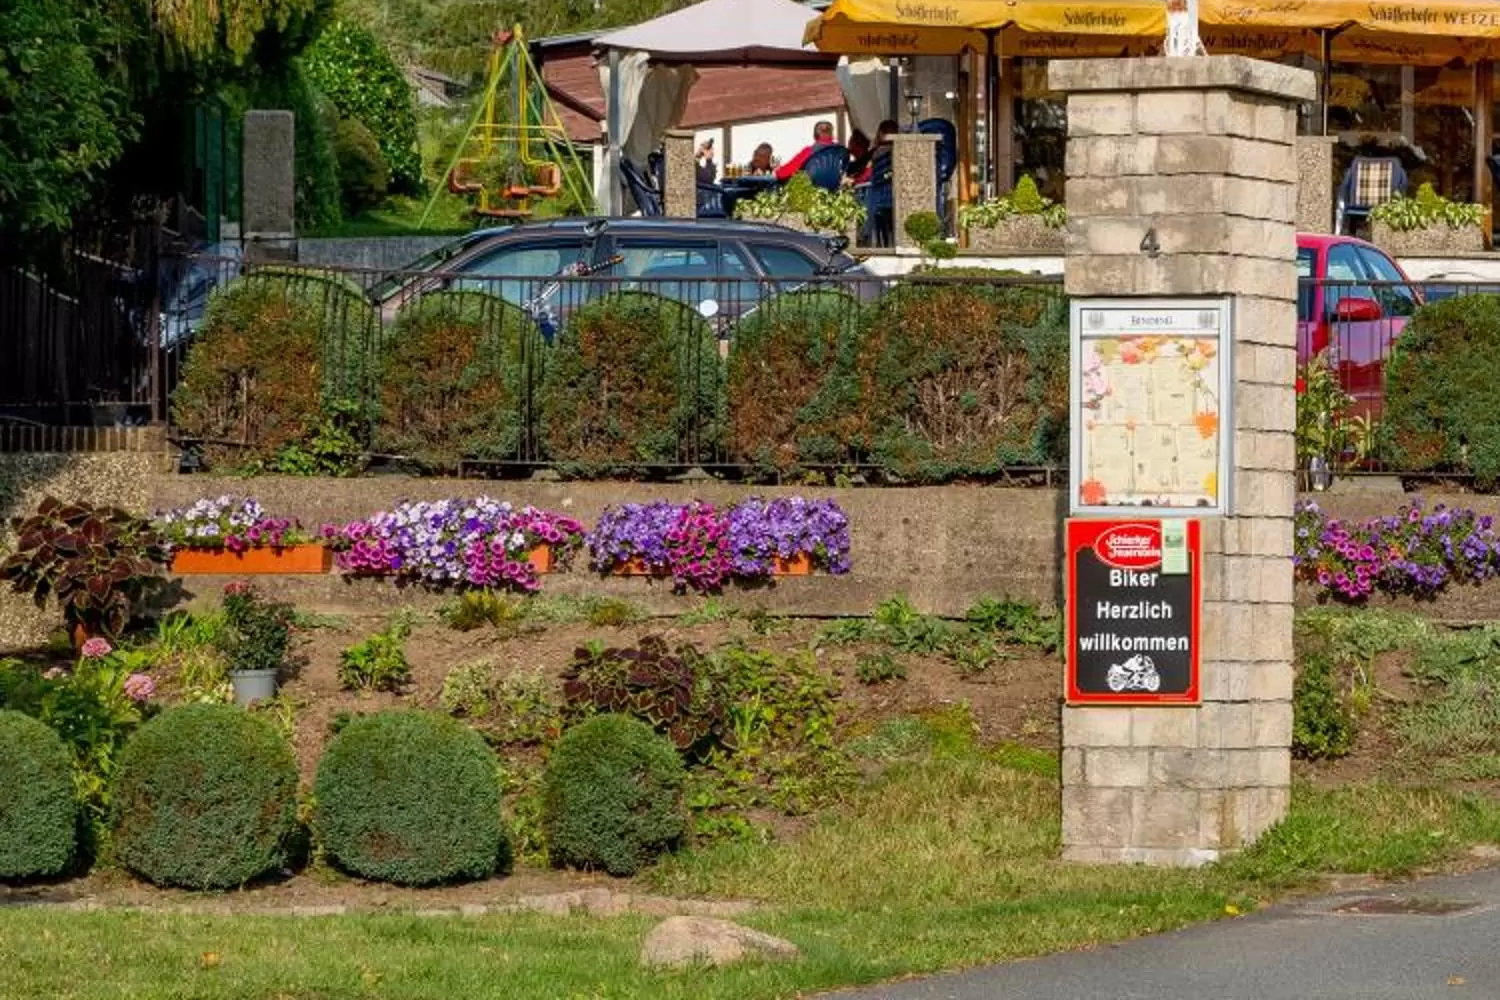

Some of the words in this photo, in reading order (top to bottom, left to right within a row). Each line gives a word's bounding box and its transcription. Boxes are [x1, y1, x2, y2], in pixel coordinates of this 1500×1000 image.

[1139, 227, 1161, 257] 4
[1109, 569, 1158, 587] Biker
[1096, 601, 1173, 619] Herzlich
[1079, 633, 1189, 651] willkommen
